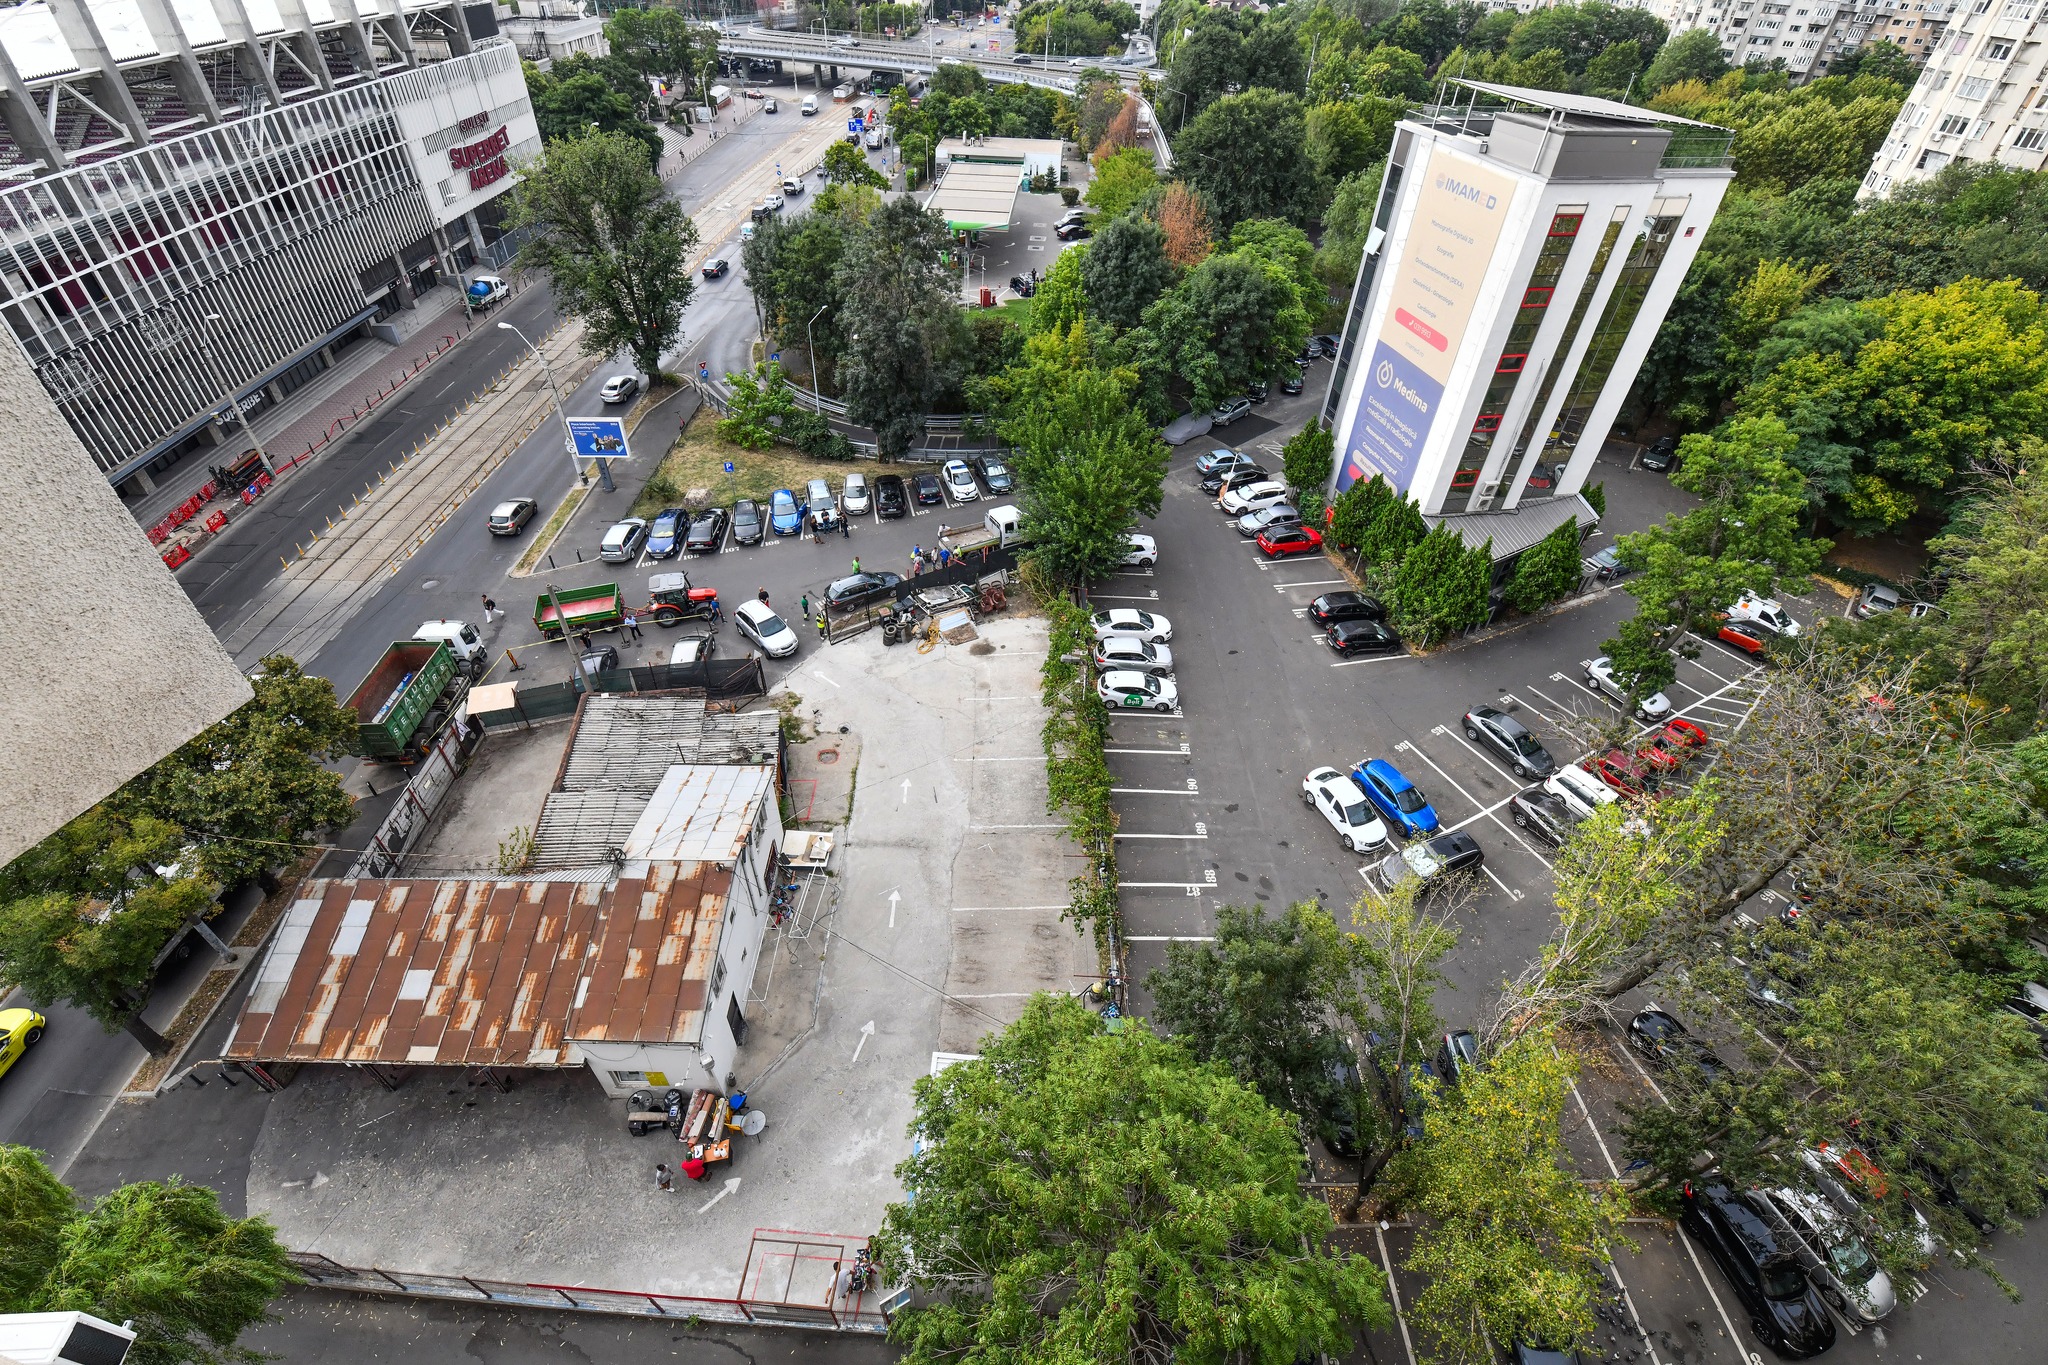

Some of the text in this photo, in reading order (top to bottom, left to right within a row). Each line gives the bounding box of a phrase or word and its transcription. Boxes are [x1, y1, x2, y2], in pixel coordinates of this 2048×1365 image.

[449, 124, 510, 169] SUPERBET
[469, 154, 510, 191] ARENA
[1445, 177, 1497, 210] IMAMED
[1393, 377, 1428, 413] Medima
[1368, 395, 1390, 417] Excelență
[1367, 407, 1387, 426] medicală
[1390, 426, 1412, 449] radiologie
[1362, 441, 1398, 476] Computer tomograf
[724, 546, 740, 554] 107
[641, 560, 658, 568] 109
[1150, 590, 1158, 598] 96
[1314, 638, 1325, 646] 16
[1549, 673, 1562, 682] 82
[1126, 697, 1140, 705] Bolt
[1500, 695, 1514, 704] 83
[1430, 726, 1444, 736] 85
[1180, 742, 1190, 752] 91
[1394, 742, 1409, 752] 86
[1186, 778, 1198, 790] 90
[1194, 822, 1207, 835] 89
[1204, 869, 1216, 883] 88
[1186, 886, 1201, 897] 87
[1513, 888, 1526, 900] 2
[1760, 890, 1776, 904] 65
